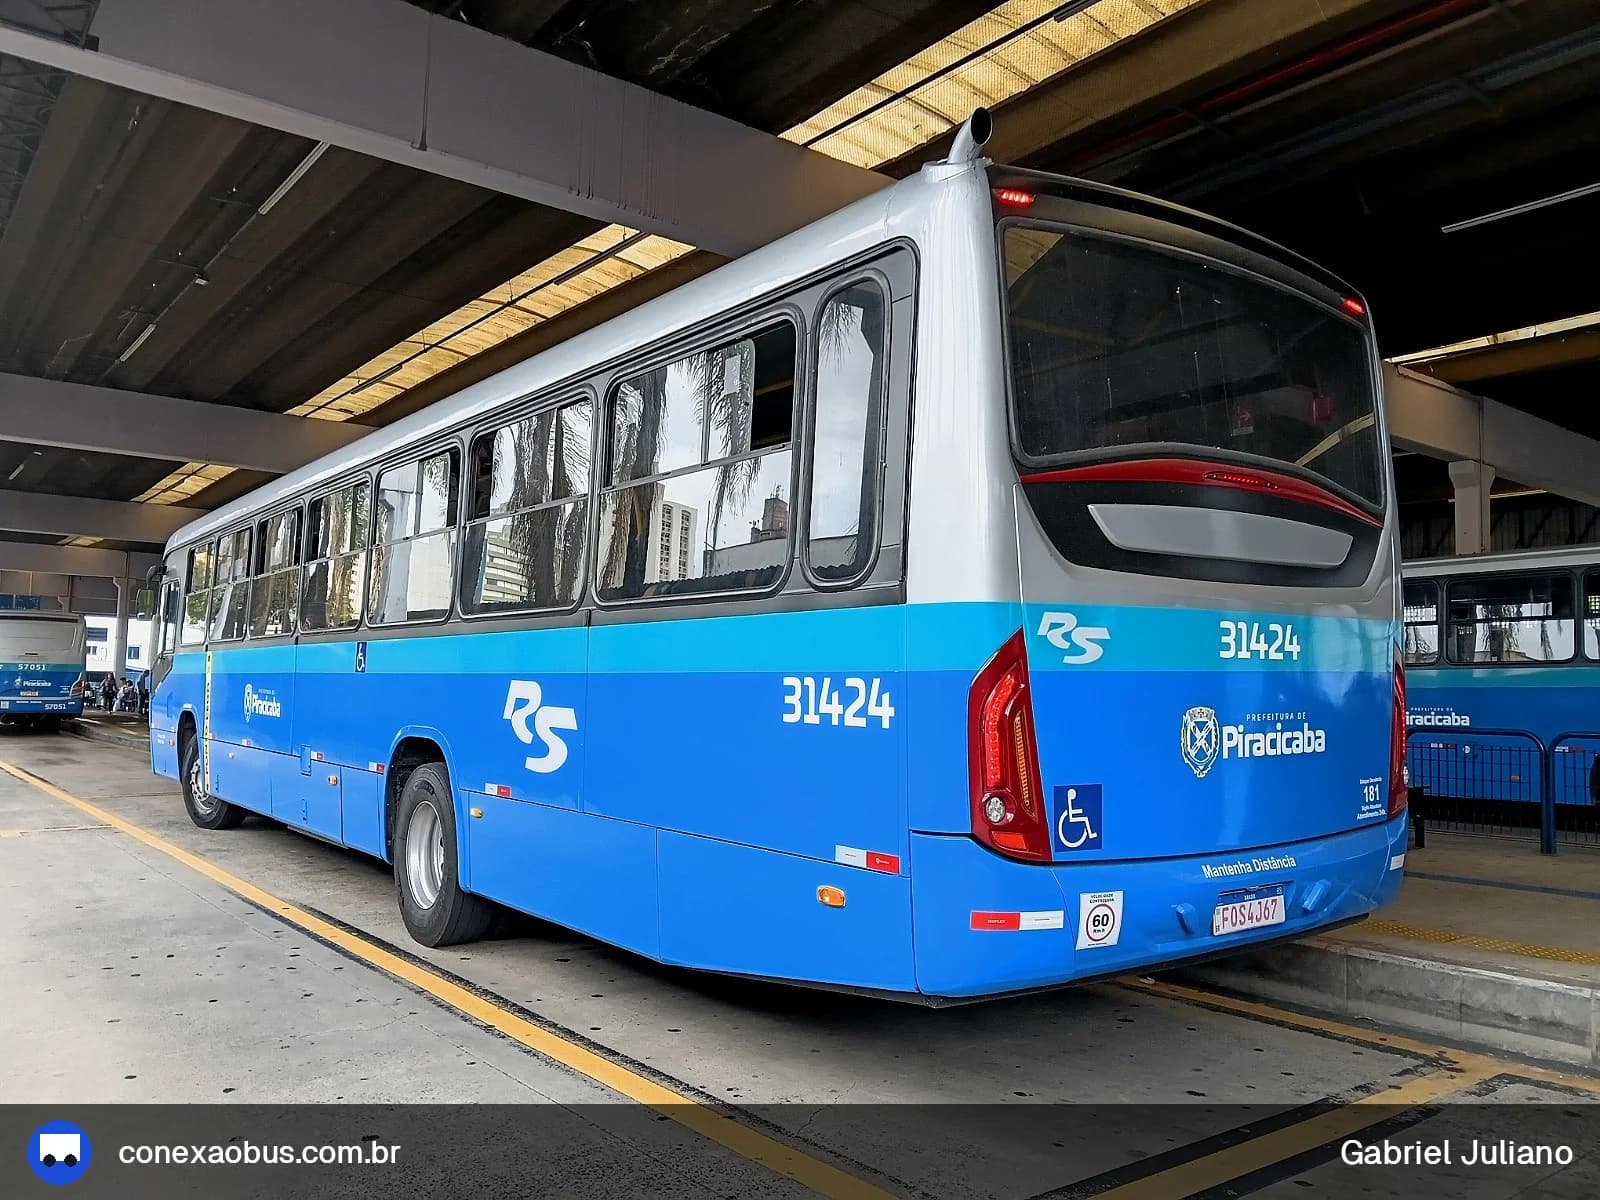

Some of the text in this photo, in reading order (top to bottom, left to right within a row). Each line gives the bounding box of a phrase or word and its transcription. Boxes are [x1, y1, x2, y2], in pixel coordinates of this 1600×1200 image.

[1037, 611, 1111, 665] RS
[1219, 620, 1301, 661] 31424
[17, 663, 46, 671] 57051
[782, 676, 895, 729] 31424
[503, 679, 578, 773] RS
[1246, 711, 1307, 722] PREFEITURA DE
[1405, 711, 1470, 727] iracicaba
[1222, 722, 1326, 760] Piracicaba
[1363, 783, 1380, 803] 181
[1201, 854, 1297, 879] Mantenha Distância
[1092, 913, 1110, 928] 60
